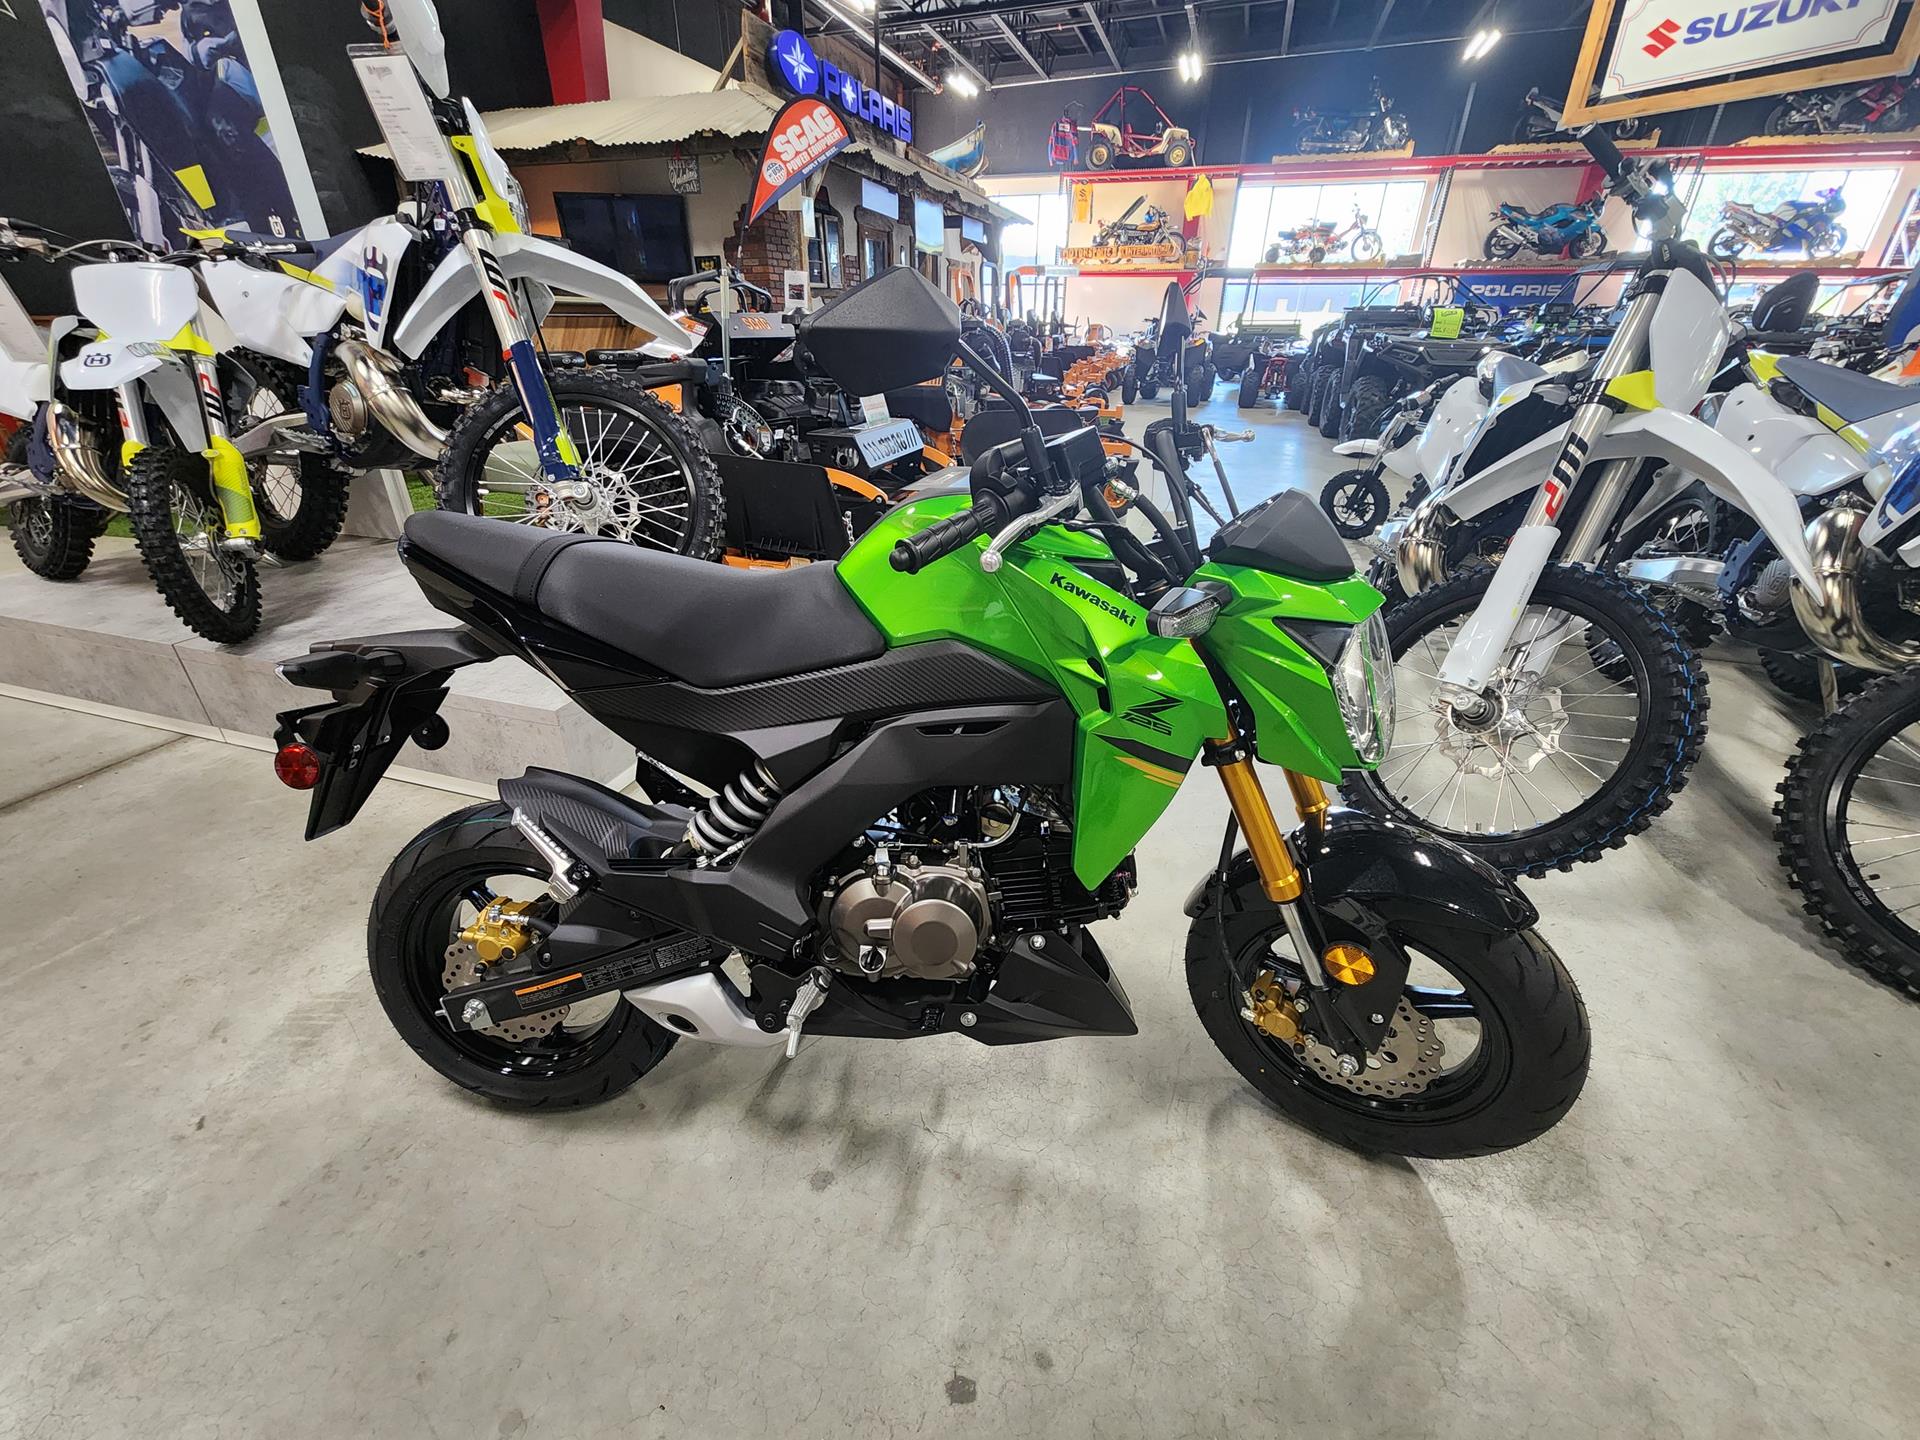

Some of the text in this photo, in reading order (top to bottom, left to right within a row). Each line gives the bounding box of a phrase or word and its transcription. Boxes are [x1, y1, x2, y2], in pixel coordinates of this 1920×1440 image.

[822, 58, 913, 144] POLARIS
[772, 105, 836, 162] SCAG
[786, 127, 844, 174] POWER EQUIPMENT
[771, 162, 785, 176] USA
[1469, 284, 1562, 297] POLARIS
[1050, 572, 1136, 628] Kawasaki
[1117, 711, 1173, 737] 125
[1126, 685, 1185, 728] Z
